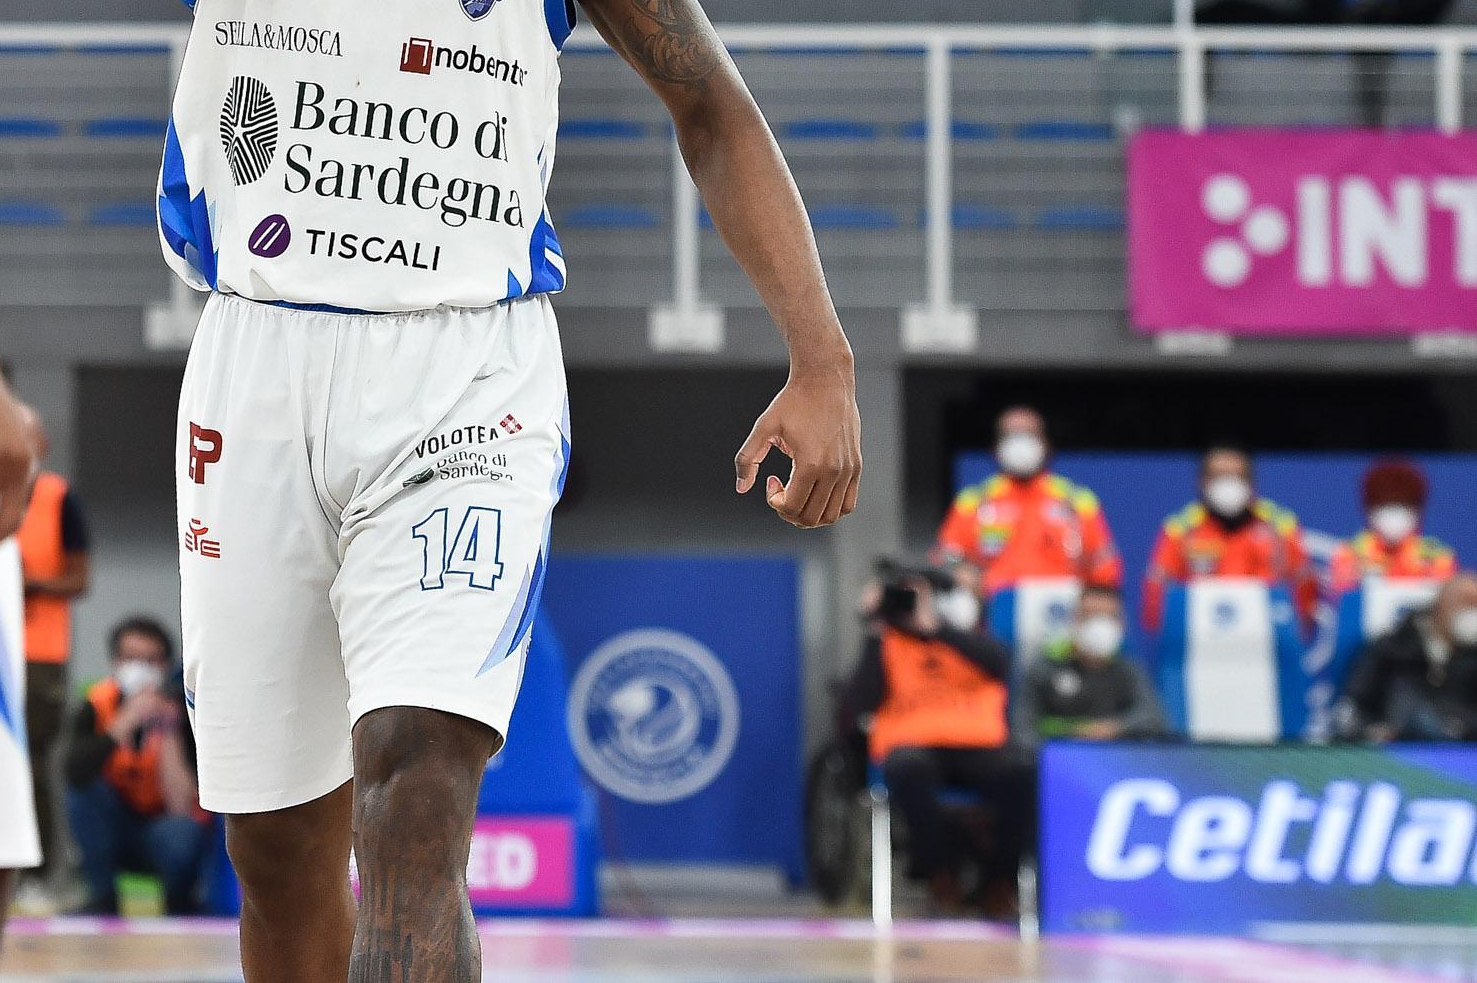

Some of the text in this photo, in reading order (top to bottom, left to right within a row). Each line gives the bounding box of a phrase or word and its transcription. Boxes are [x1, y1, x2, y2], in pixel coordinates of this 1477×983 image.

[290, 80, 509, 163] Banco di
[284, 144, 525, 229] Sardegna
[306, 229, 440, 271] TISCALI
[1296, 175, 1477, 287] INT
[415, 425, 499, 459] VOLOTEA
[491, 454, 508, 467] di
[412, 506, 505, 591] 14
[1085, 777, 1477, 885] Cetila
